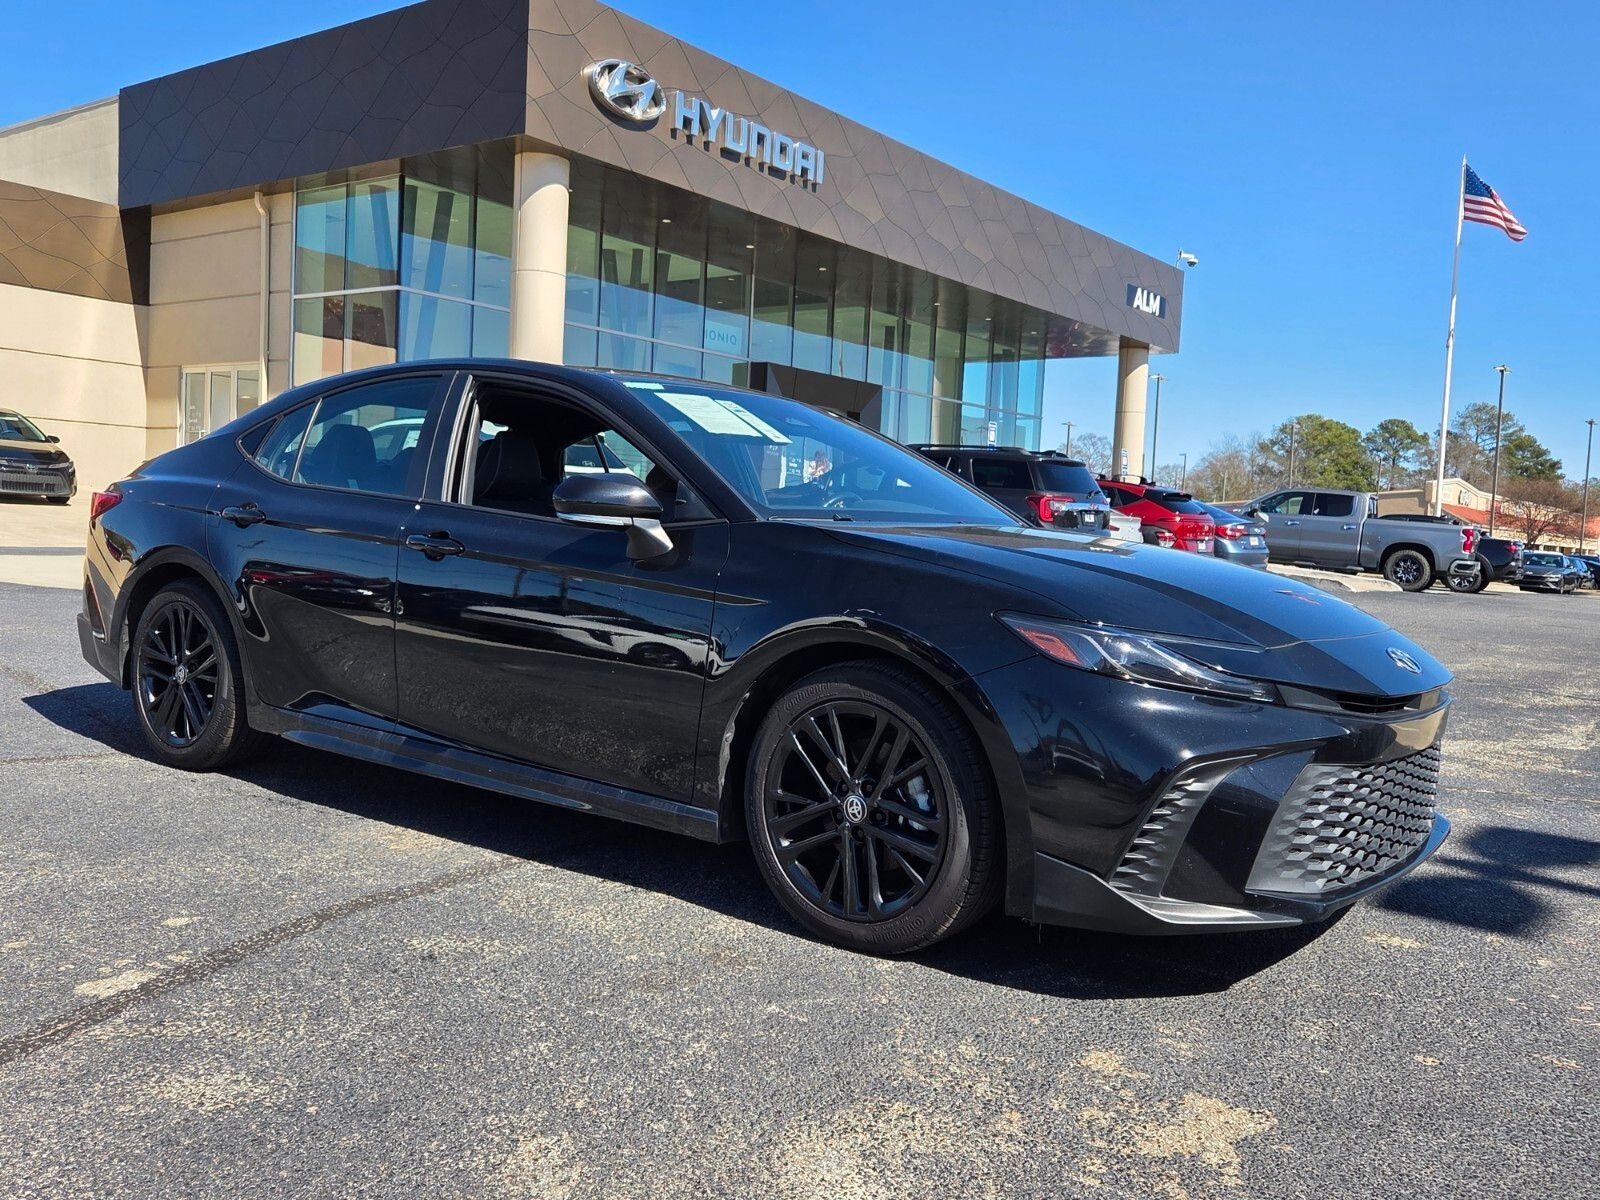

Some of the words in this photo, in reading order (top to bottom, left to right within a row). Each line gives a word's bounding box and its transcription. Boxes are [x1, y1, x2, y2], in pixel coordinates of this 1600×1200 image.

[674, 90, 825, 185] HYUNDAI
[1133, 287, 1161, 316] ALM
[705, 328, 737, 346] IONIQ
